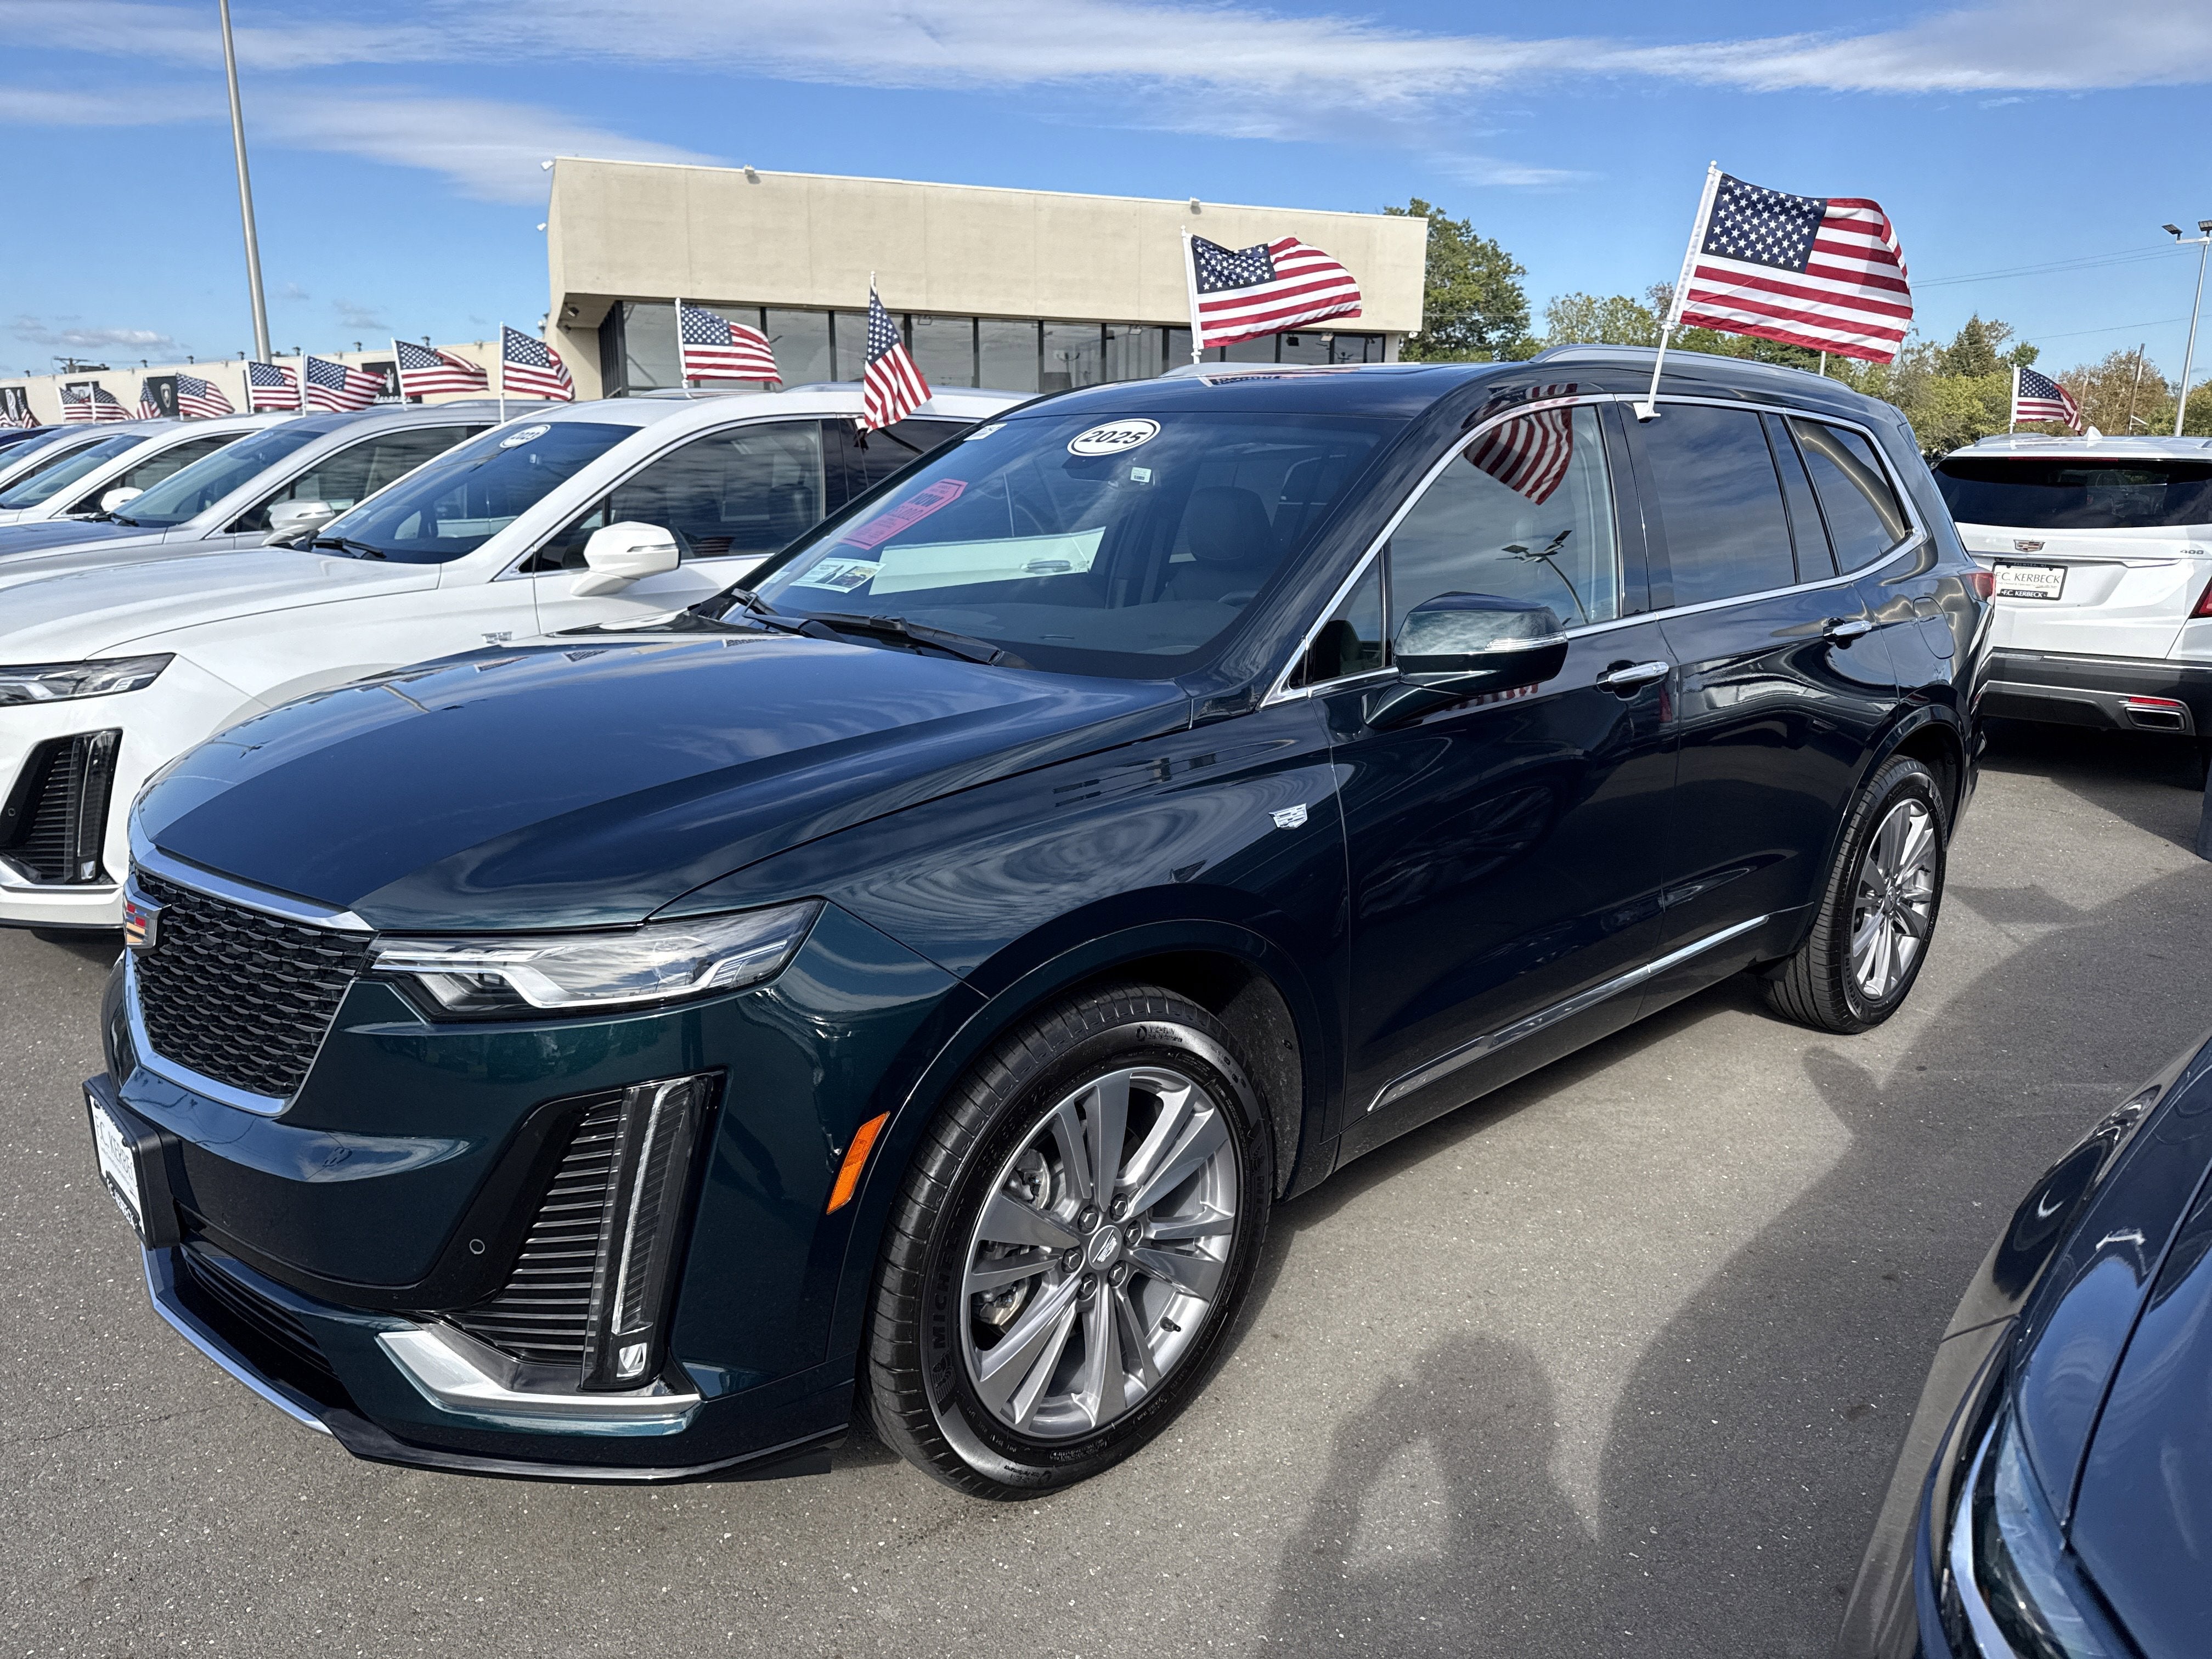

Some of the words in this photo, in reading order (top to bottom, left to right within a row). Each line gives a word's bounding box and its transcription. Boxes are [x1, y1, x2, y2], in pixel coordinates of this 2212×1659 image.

[1079, 430, 1149, 444] 2025
[907, 493, 945, 507] NOW
[2014, 573, 2061, 584] KERBECK
[1844, 957, 1861, 1009] MICHELIN
[95, 1115, 109, 1148] F.C.
[108, 1131, 137, 1187] KERBEC
